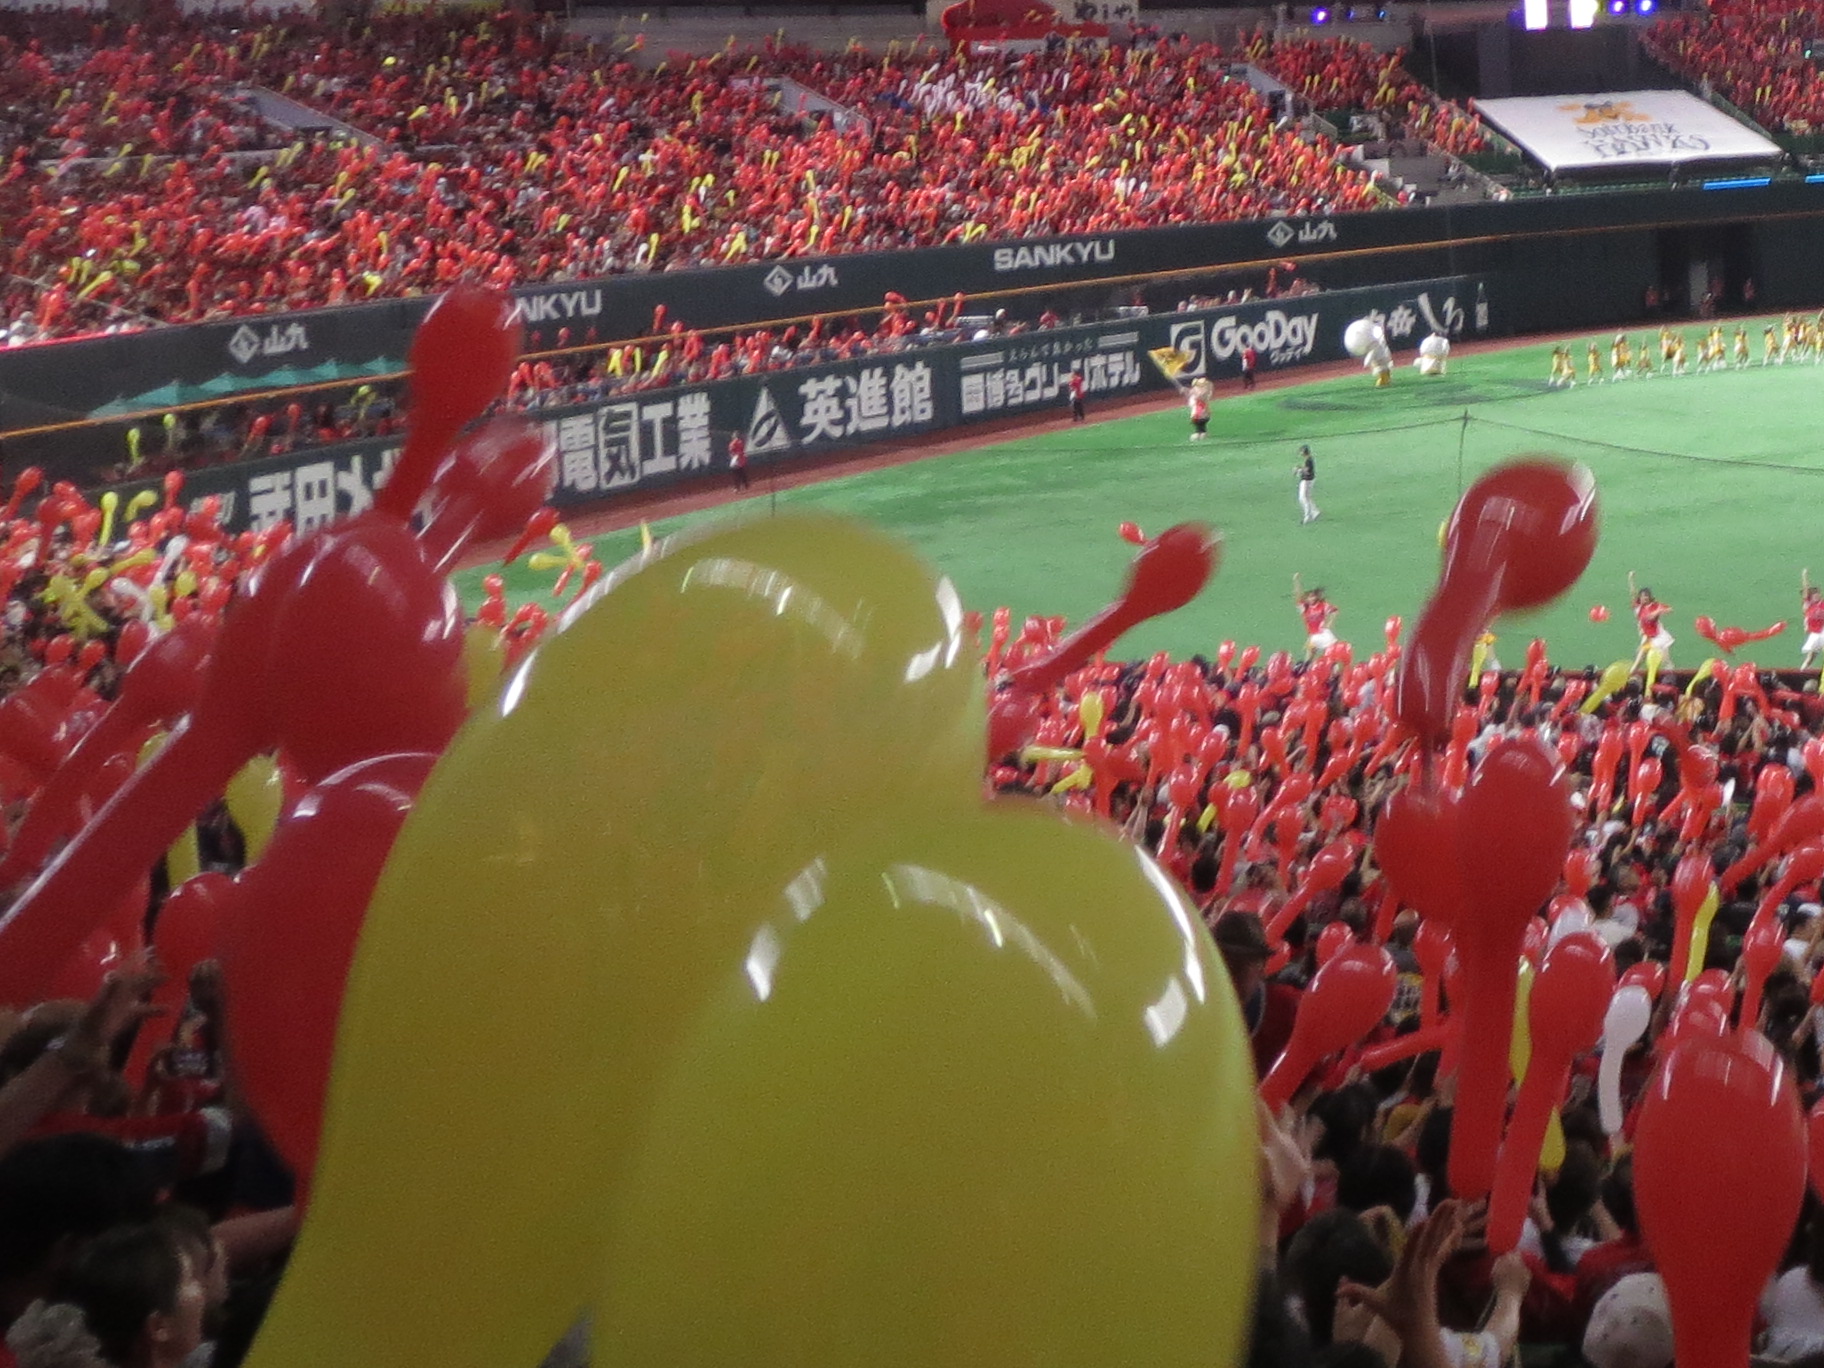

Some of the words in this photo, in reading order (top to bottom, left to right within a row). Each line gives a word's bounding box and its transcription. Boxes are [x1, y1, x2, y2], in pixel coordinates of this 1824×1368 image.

[1299, 221, 1338, 243] 山九
[994, 239, 1115, 272] SANKYU
[797, 263, 840, 290] 山九
[514, 288, 602, 323] NKYU
[1211, 310, 1319, 361] GooDay
[799, 360, 933, 446] 英進館
[556, 393, 712, 491] 電気工業
